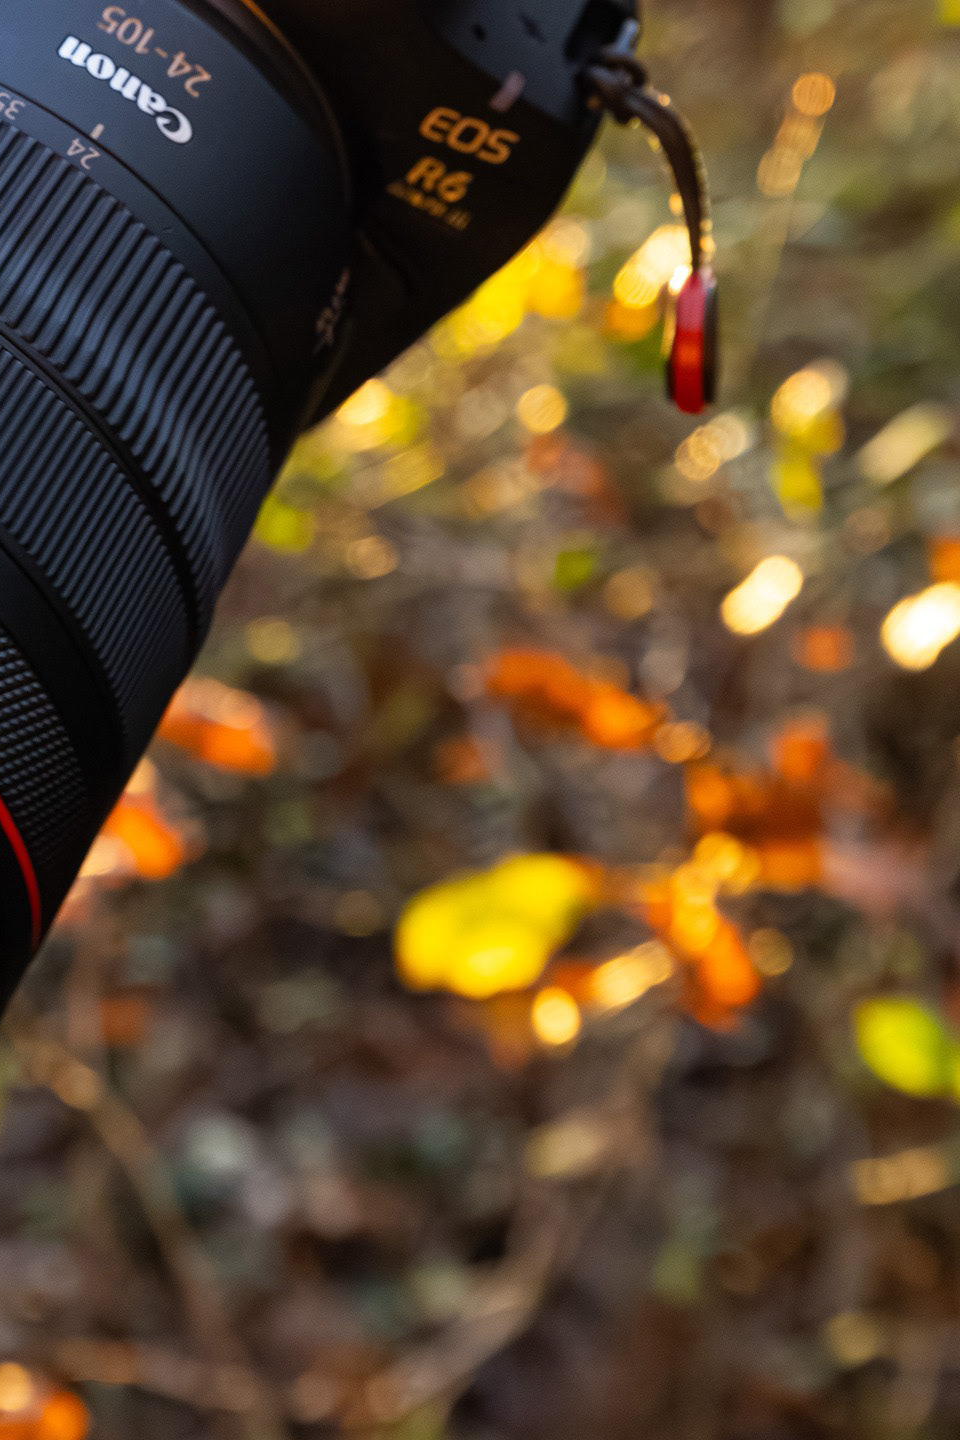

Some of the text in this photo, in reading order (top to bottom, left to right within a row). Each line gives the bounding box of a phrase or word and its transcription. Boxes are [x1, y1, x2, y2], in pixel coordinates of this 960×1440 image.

[96, 5, 212, 97] 24-105
[58, 35, 193, 144] Canon
[67, 138, 100, 170] 24
[419, 106, 520, 165] EOS
[405, 156, 474, 203] R6
